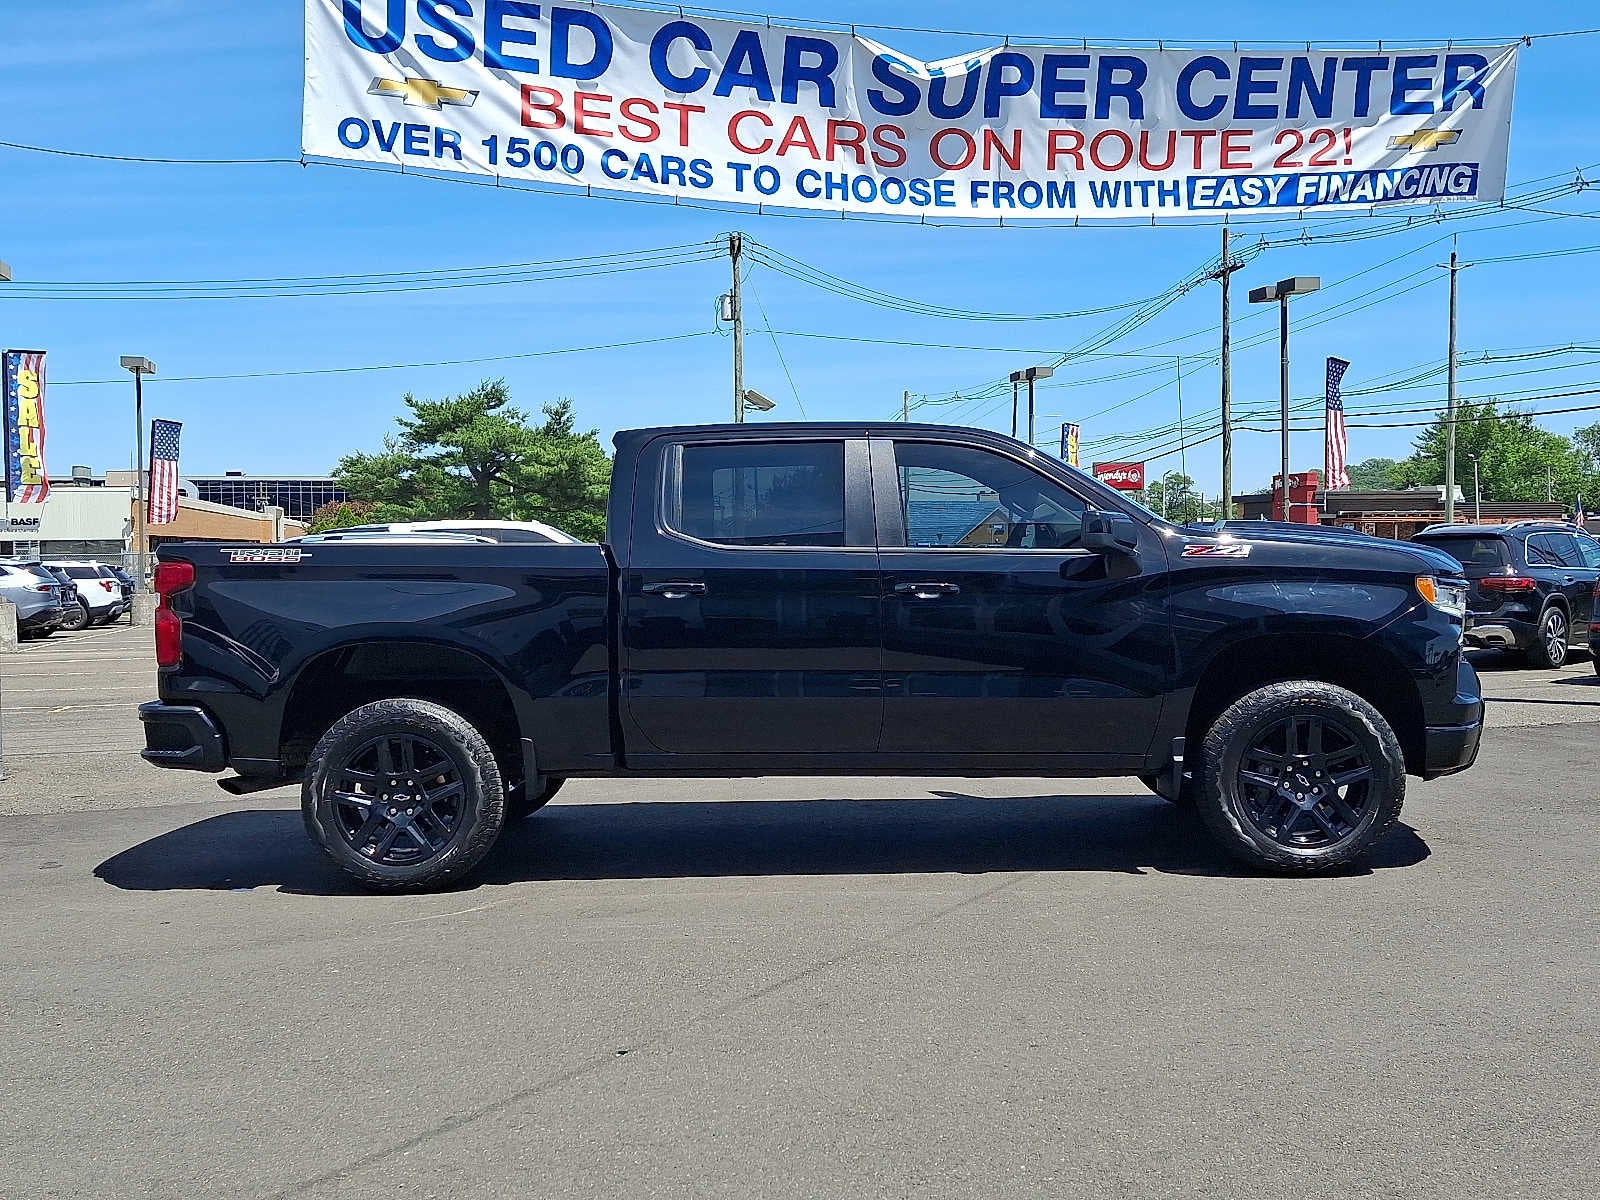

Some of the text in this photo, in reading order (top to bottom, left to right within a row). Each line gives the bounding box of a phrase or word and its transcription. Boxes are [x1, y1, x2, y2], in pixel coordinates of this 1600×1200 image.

[343, 0, 1489, 120] USED CAR SUPER CENTER
[337, 117, 1472, 209] OVER 1500 CARS TO CHOOSE FROM WITH EASY FINANCING
[520, 84, 1353, 171] BEST CARS ON ROUTE 22!
[17, 369, 42, 485] SALE
[220, 548, 312, 557] TRAIL
[230, 555, 301, 563] BOSS
